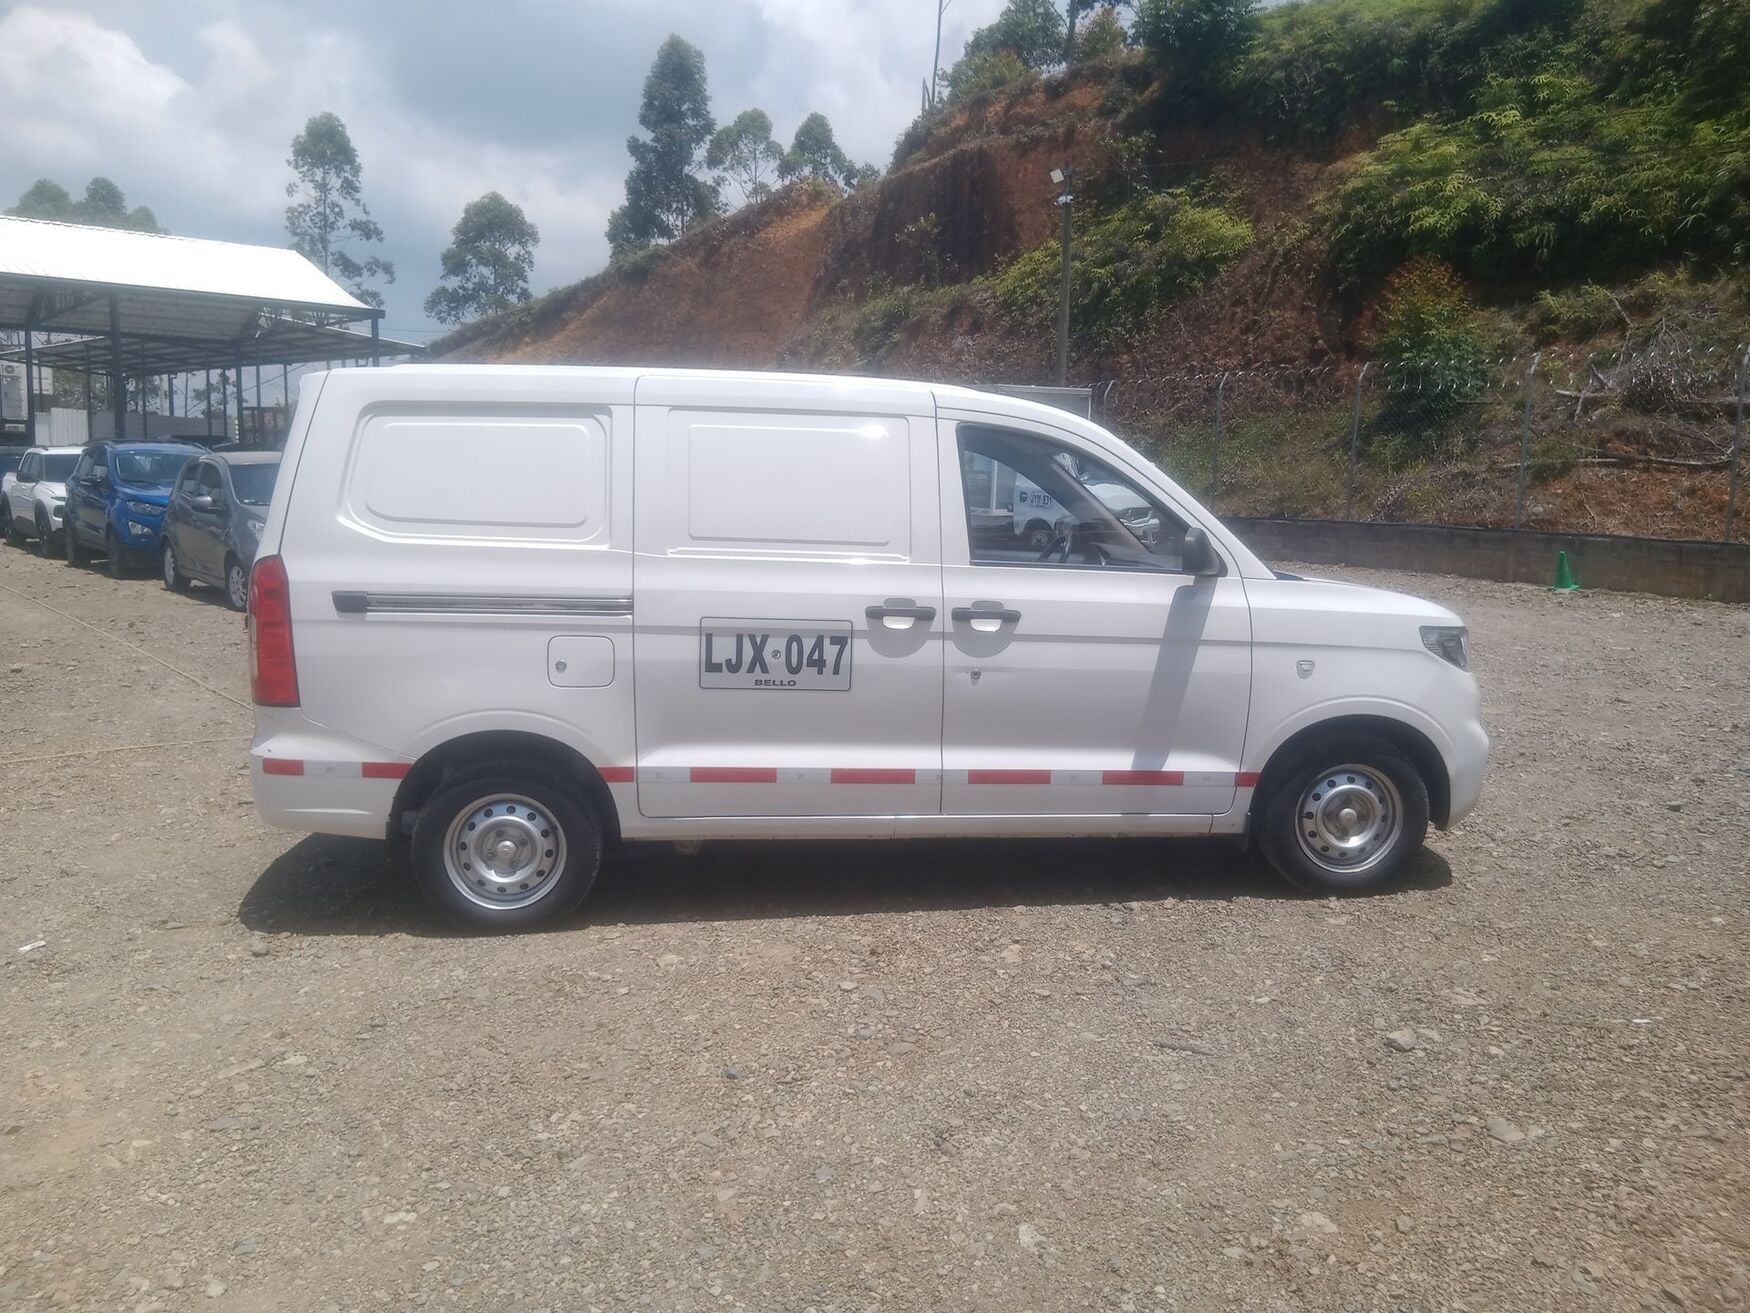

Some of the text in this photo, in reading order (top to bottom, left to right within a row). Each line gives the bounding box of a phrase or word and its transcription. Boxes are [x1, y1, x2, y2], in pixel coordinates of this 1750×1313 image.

[704, 633, 849, 675] LJX 047
[754, 679, 797, 687] BELLO
